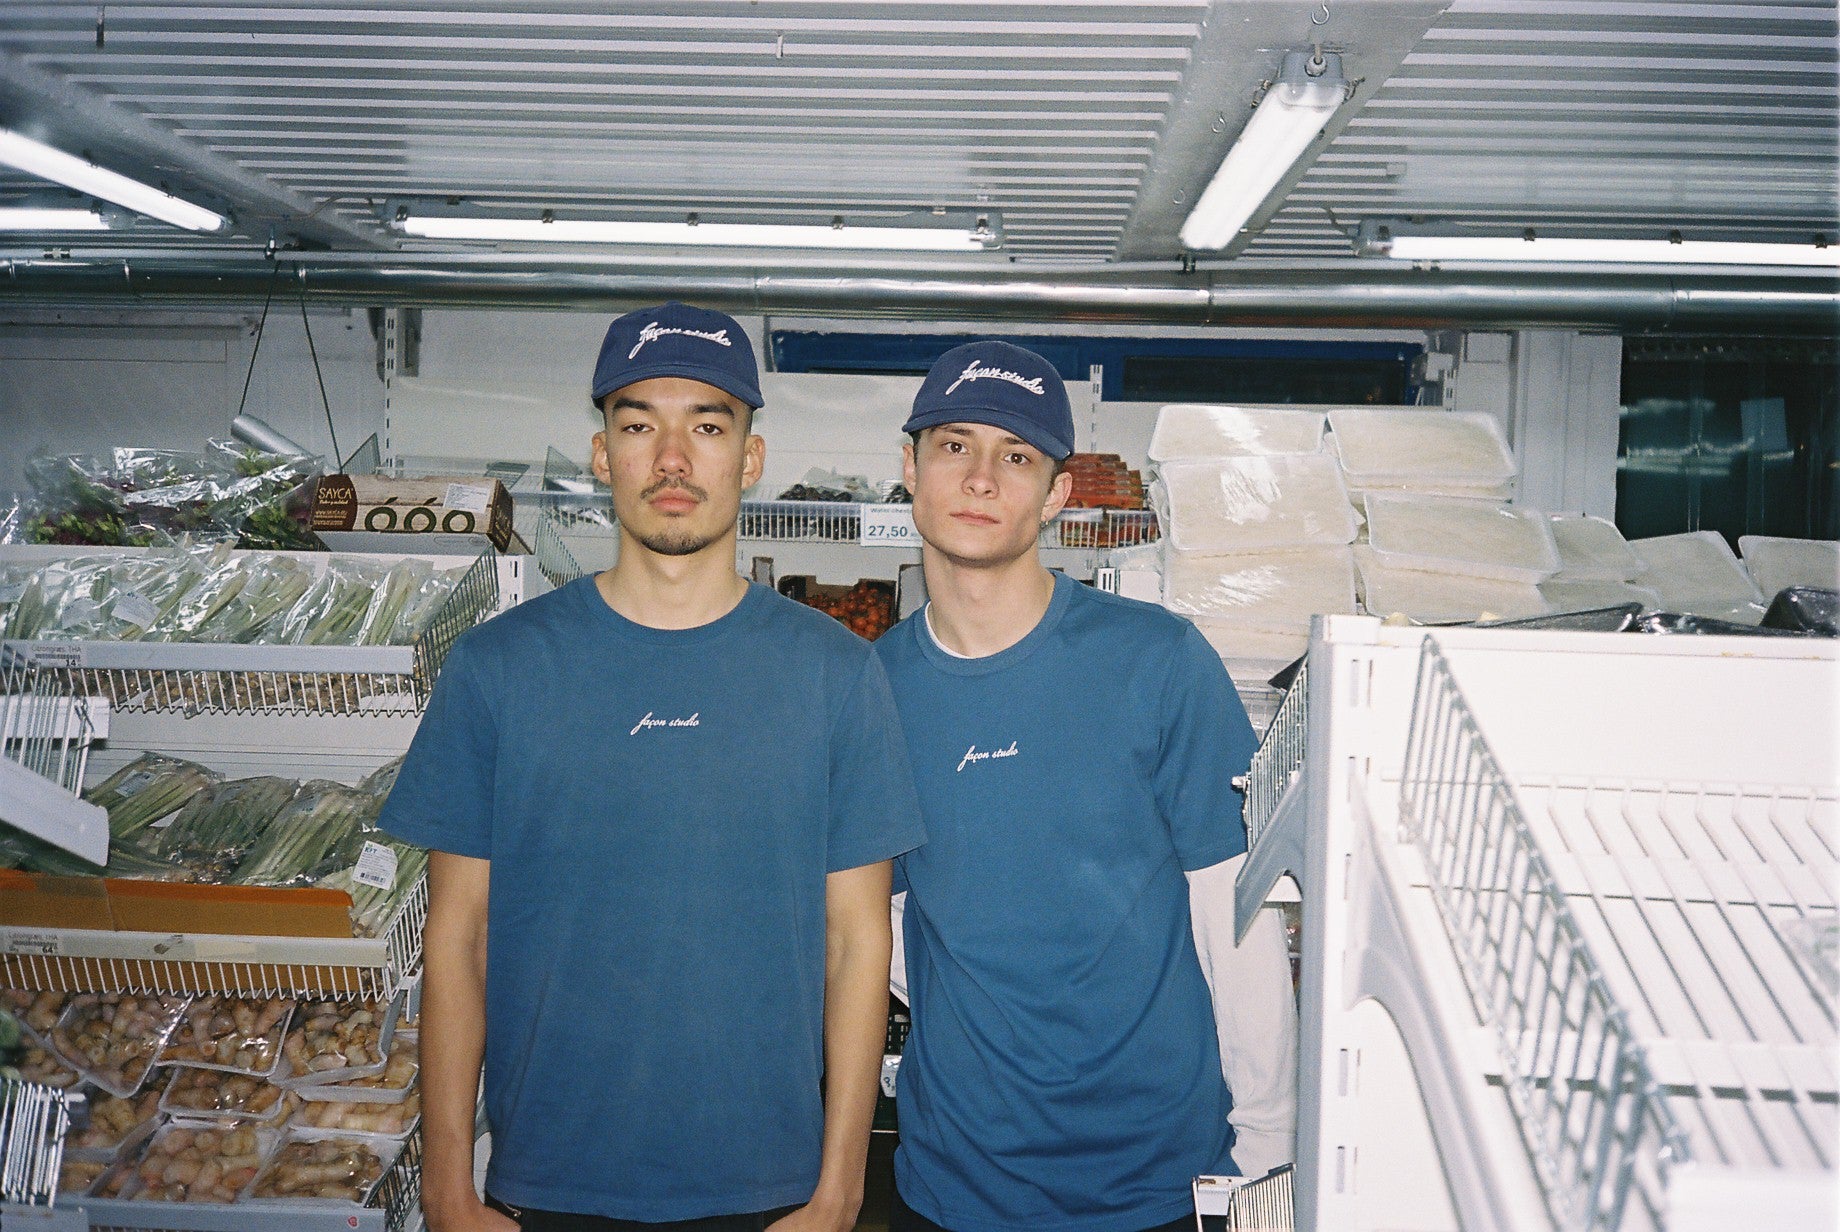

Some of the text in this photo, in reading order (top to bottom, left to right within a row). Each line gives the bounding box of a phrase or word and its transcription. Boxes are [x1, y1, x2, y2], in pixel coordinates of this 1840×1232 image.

[945, 360, 1001, 395] façon
[318, 487, 352, 499] SAYCA
[868, 525, 908, 538] 27,50
[630, 711, 699, 735] façon studio
[956, 740, 1018, 772] façon studio
